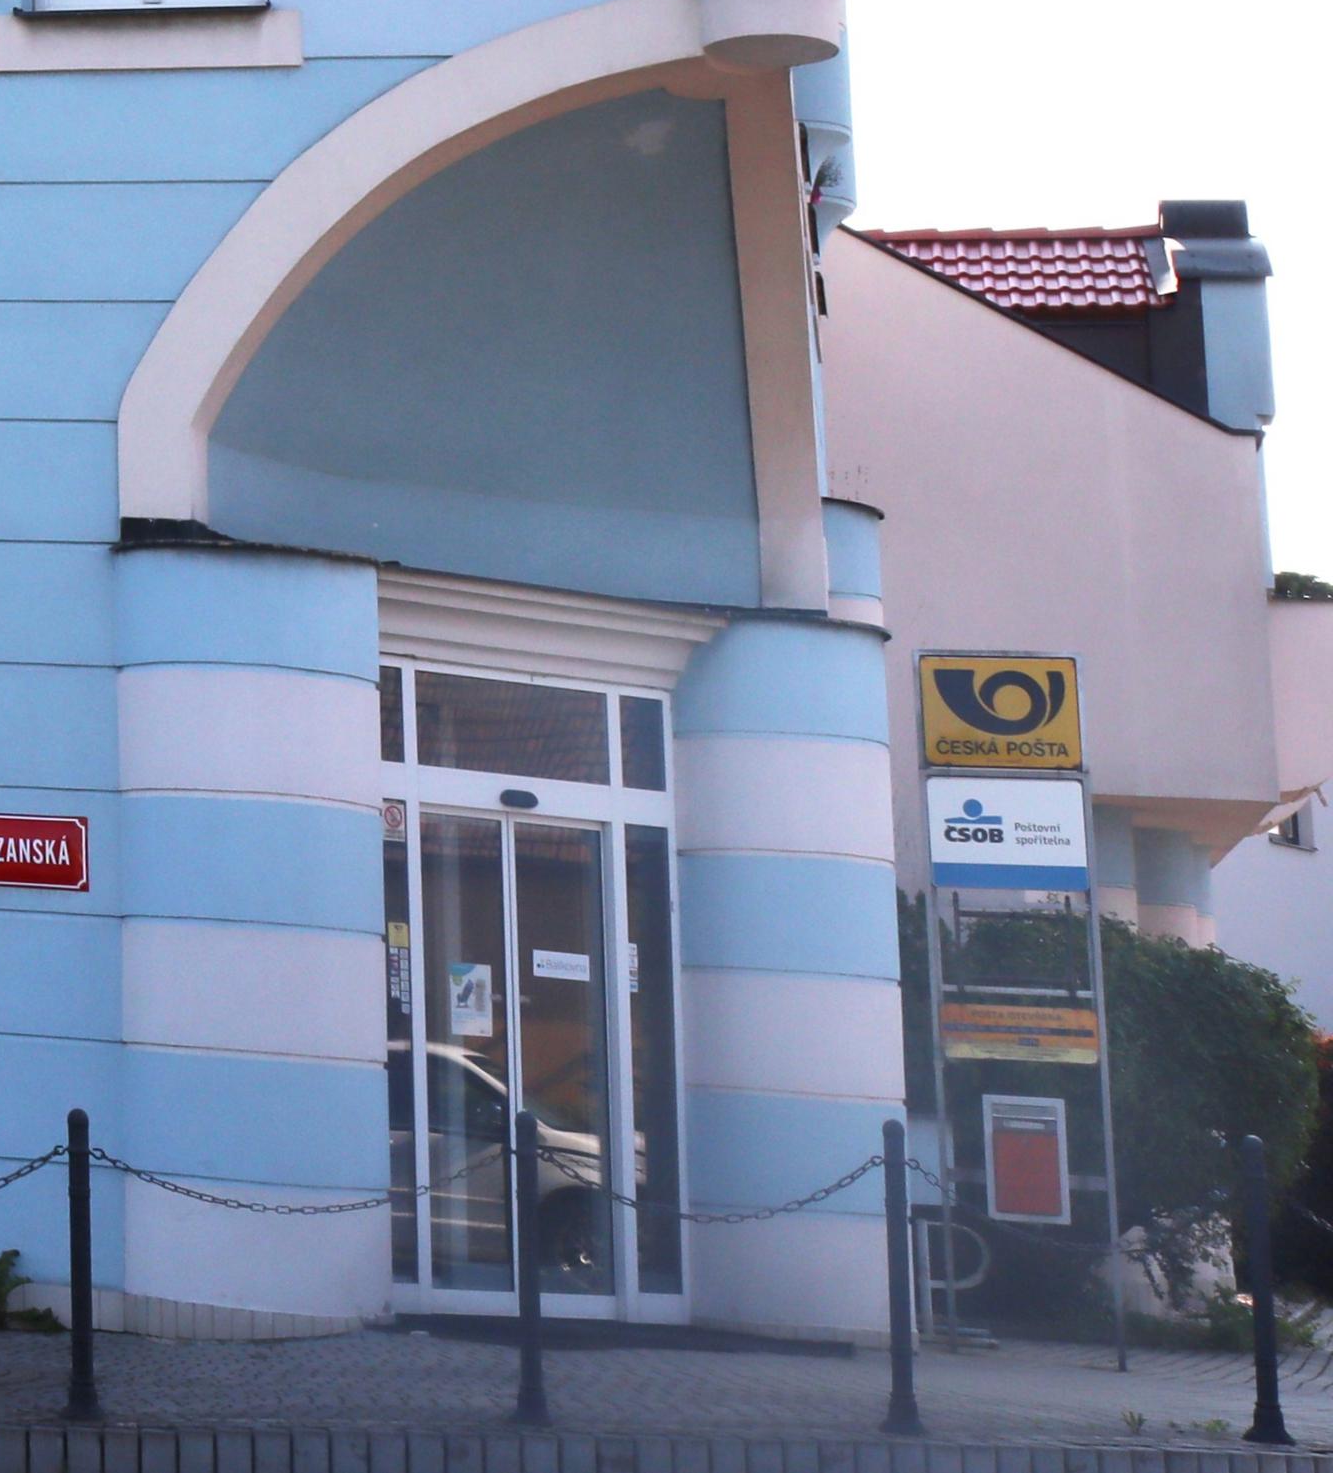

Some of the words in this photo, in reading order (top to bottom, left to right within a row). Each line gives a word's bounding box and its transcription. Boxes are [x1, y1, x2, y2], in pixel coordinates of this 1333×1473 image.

[936, 737, 999, 756] ČESKÁ
[1006, 738, 1069, 757] POŠTA
[944, 825, 1004, 843] ČSOB
[1014, 822, 1061, 833] Poštovní
[1015, 835, 1071, 847] spořitelna
